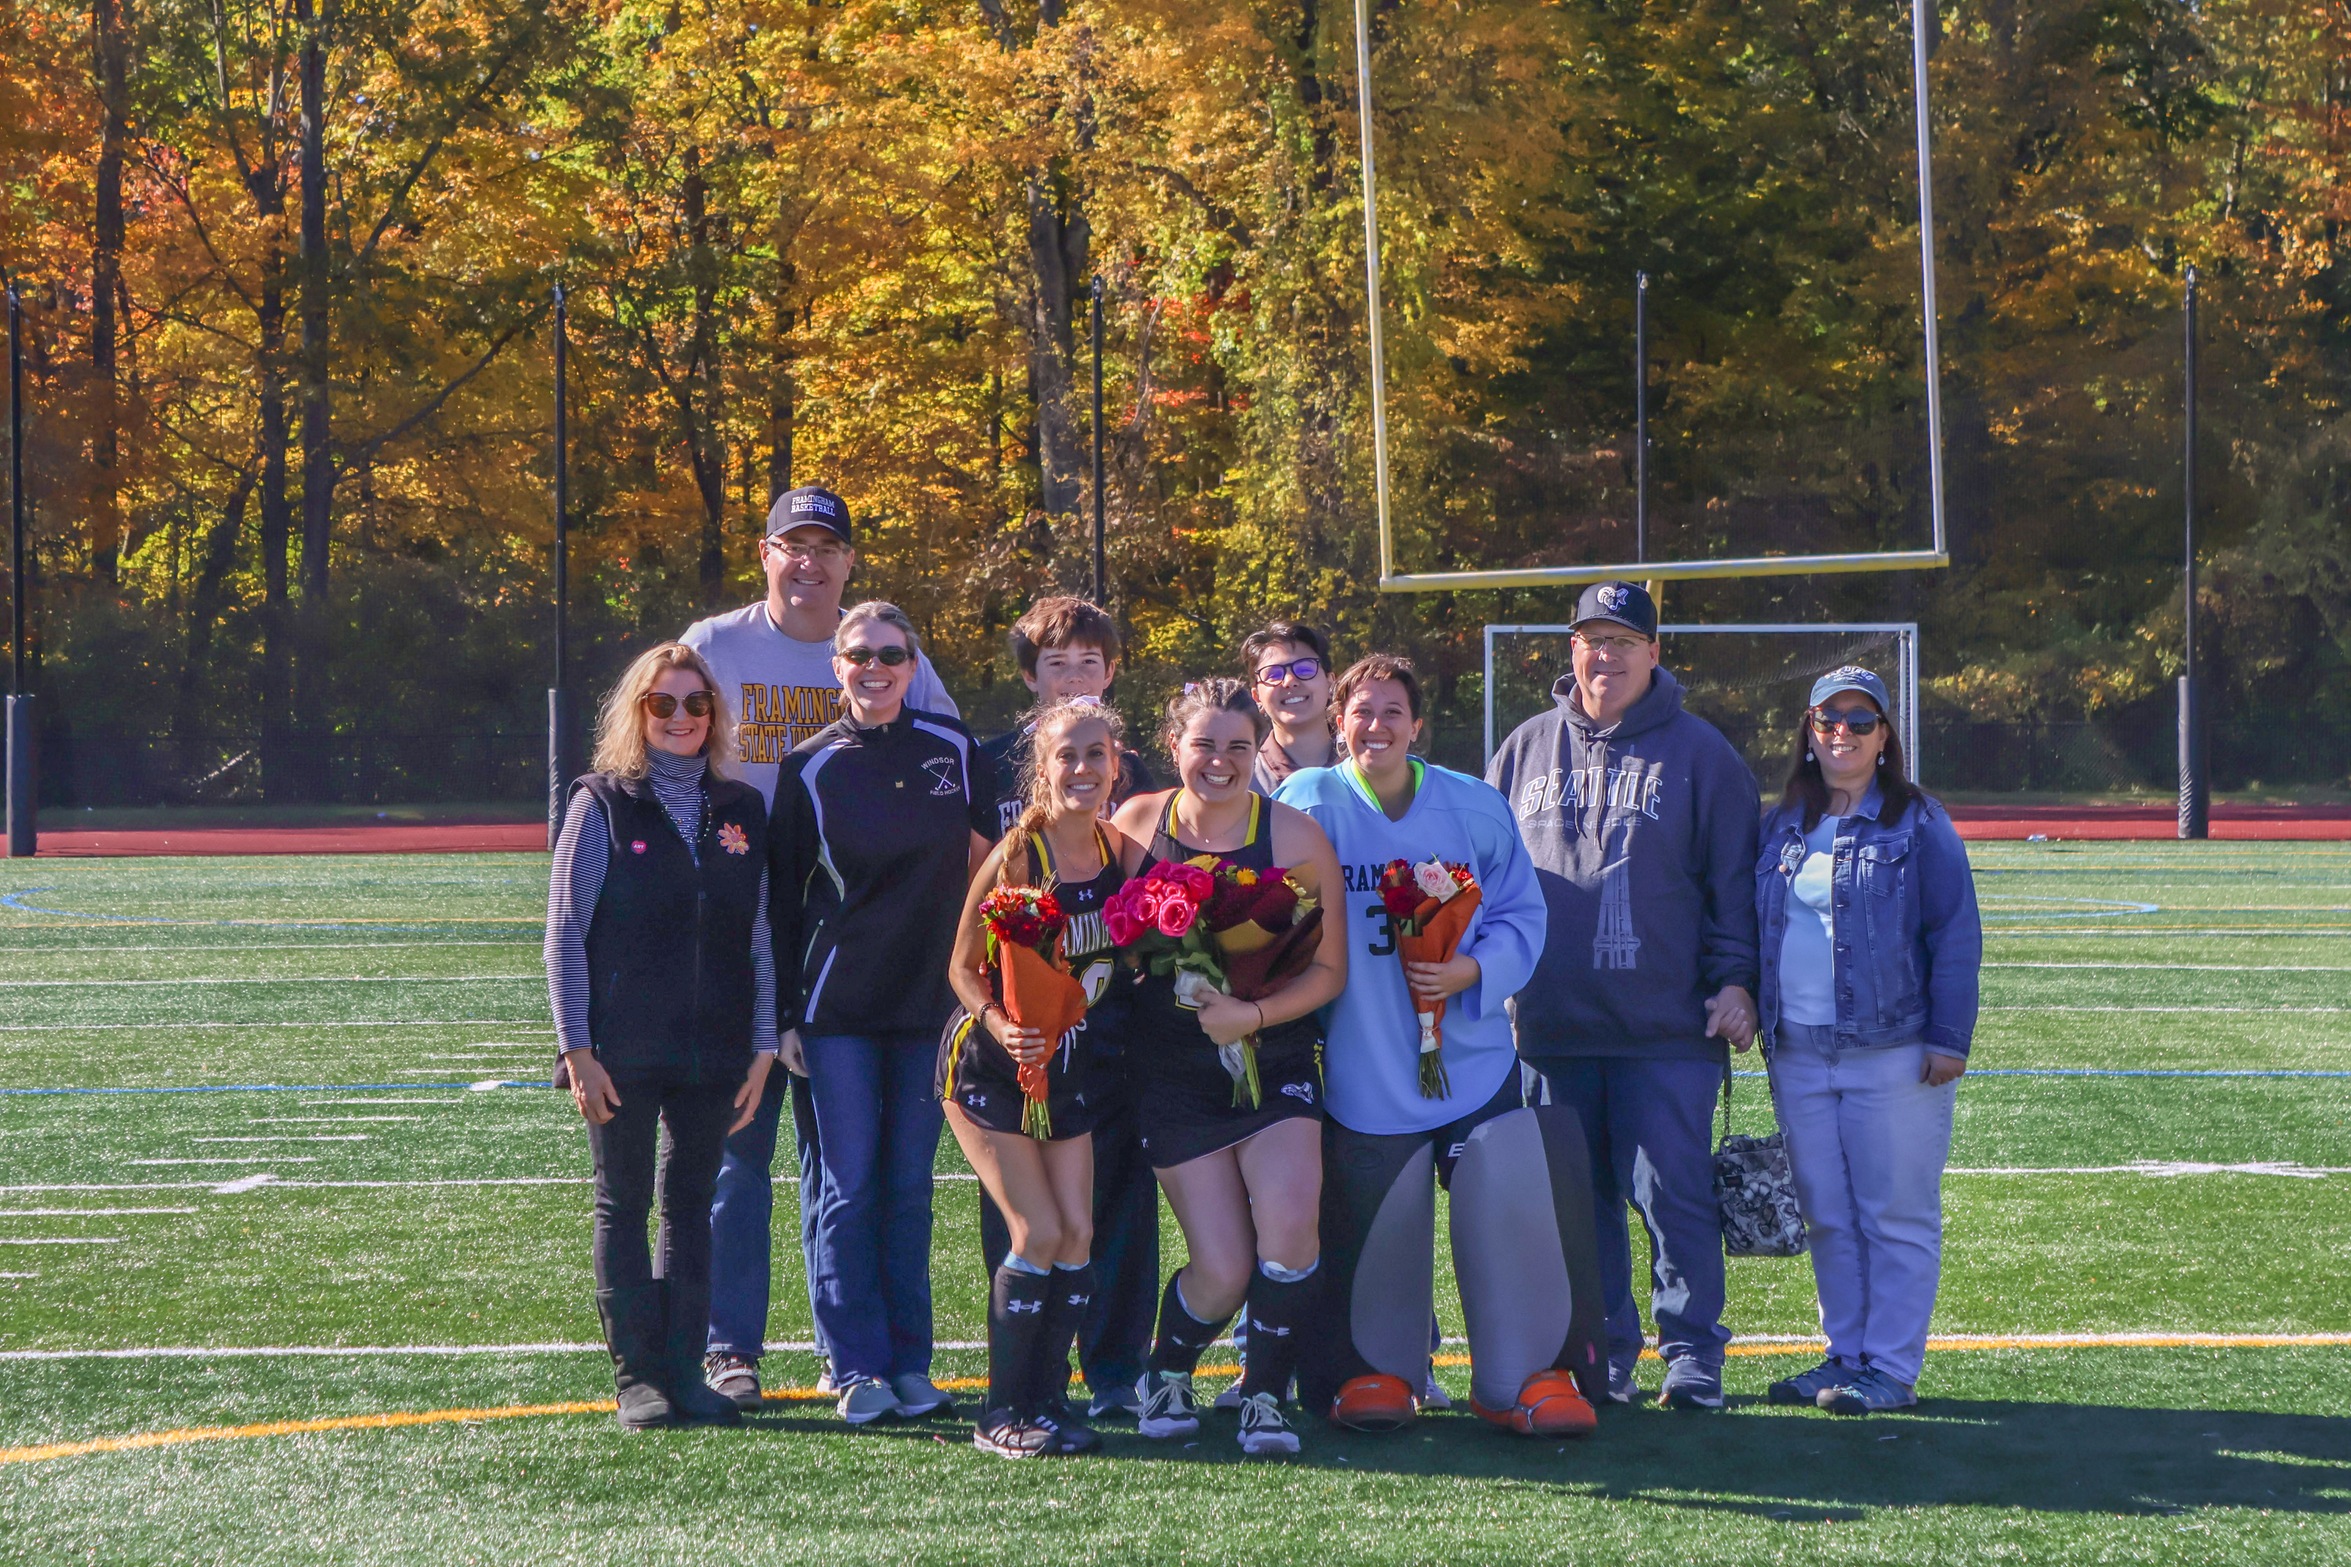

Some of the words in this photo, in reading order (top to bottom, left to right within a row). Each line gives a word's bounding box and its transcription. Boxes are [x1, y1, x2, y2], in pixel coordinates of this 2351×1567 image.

[791, 494, 835, 508] FRAMINGHAM
[791, 503, 836, 516] BASKETBALL
[741, 683, 845, 725] FRAMING
[739, 723, 787, 764] STATE
[920, 757, 955, 770] WINDSOR
[1519, 766, 1663, 821] SEATTLE
[1527, 818, 1575, 830] SPACE
